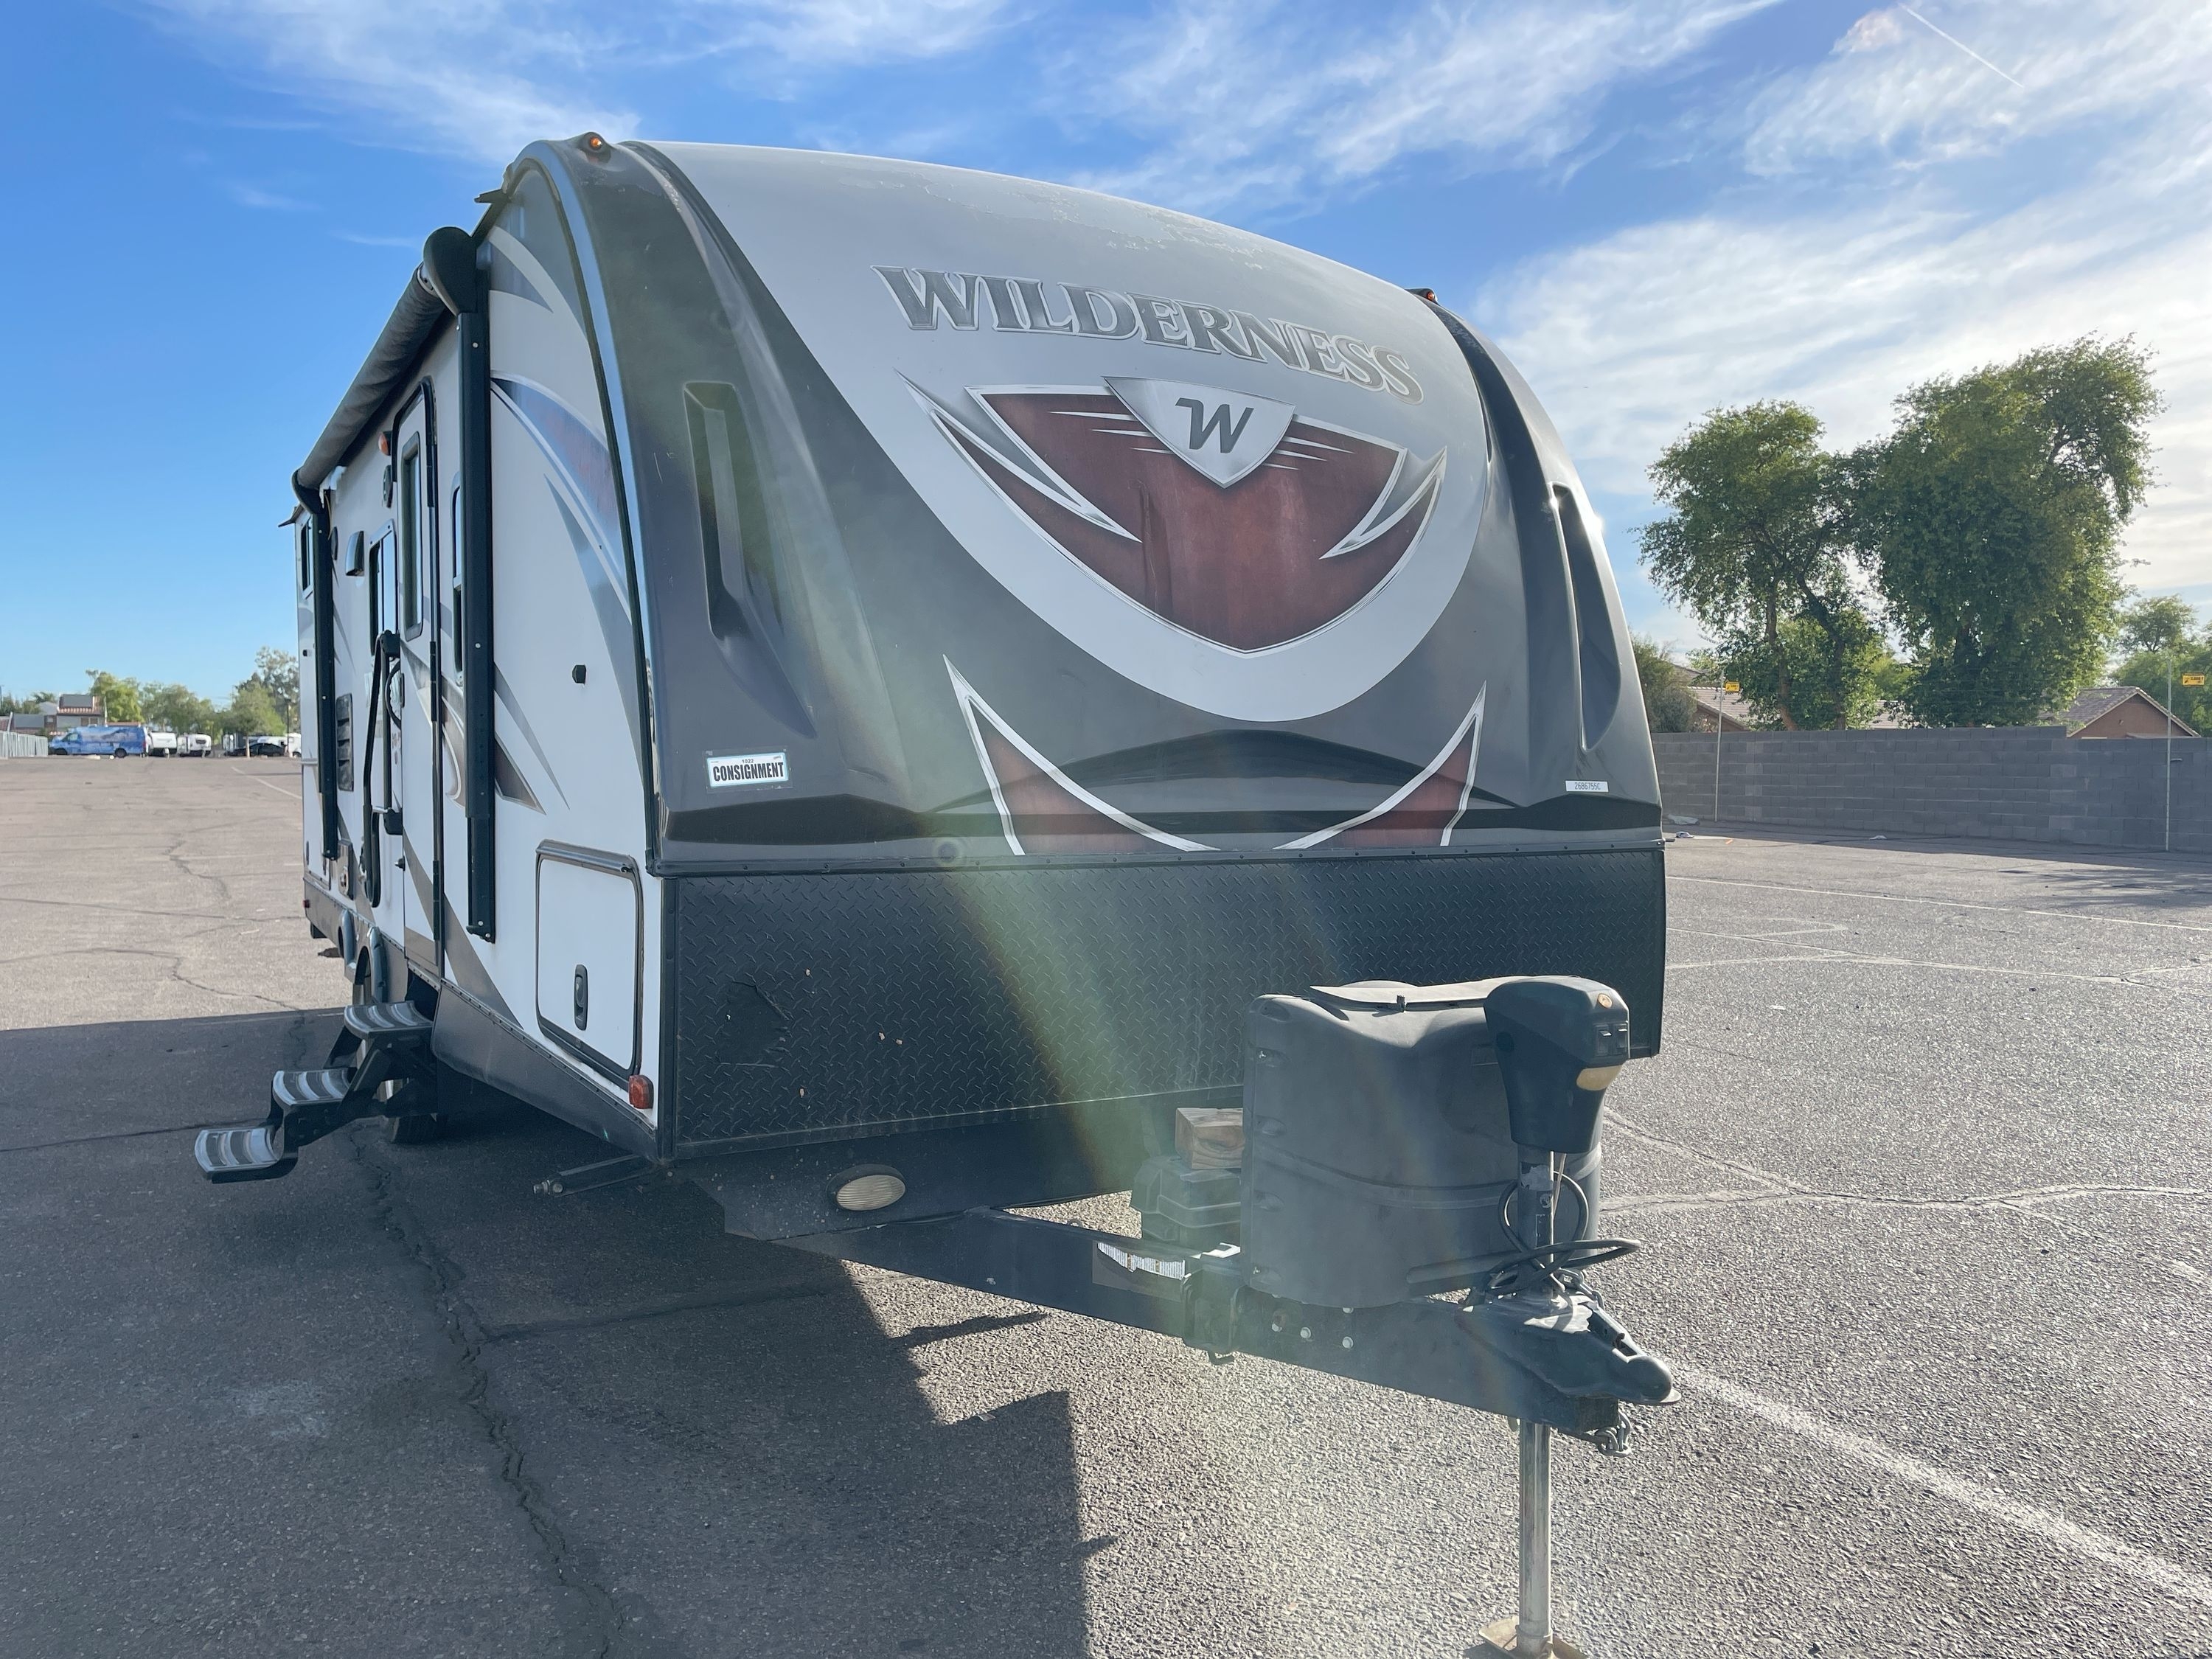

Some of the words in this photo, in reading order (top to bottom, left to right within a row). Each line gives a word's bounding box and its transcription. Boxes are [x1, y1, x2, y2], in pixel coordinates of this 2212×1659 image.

[871, 265, 1425, 405] WILDERNESS
[1175, 397, 1254, 454] W
[712, 762, 785, 782] CONSIGNMENT
